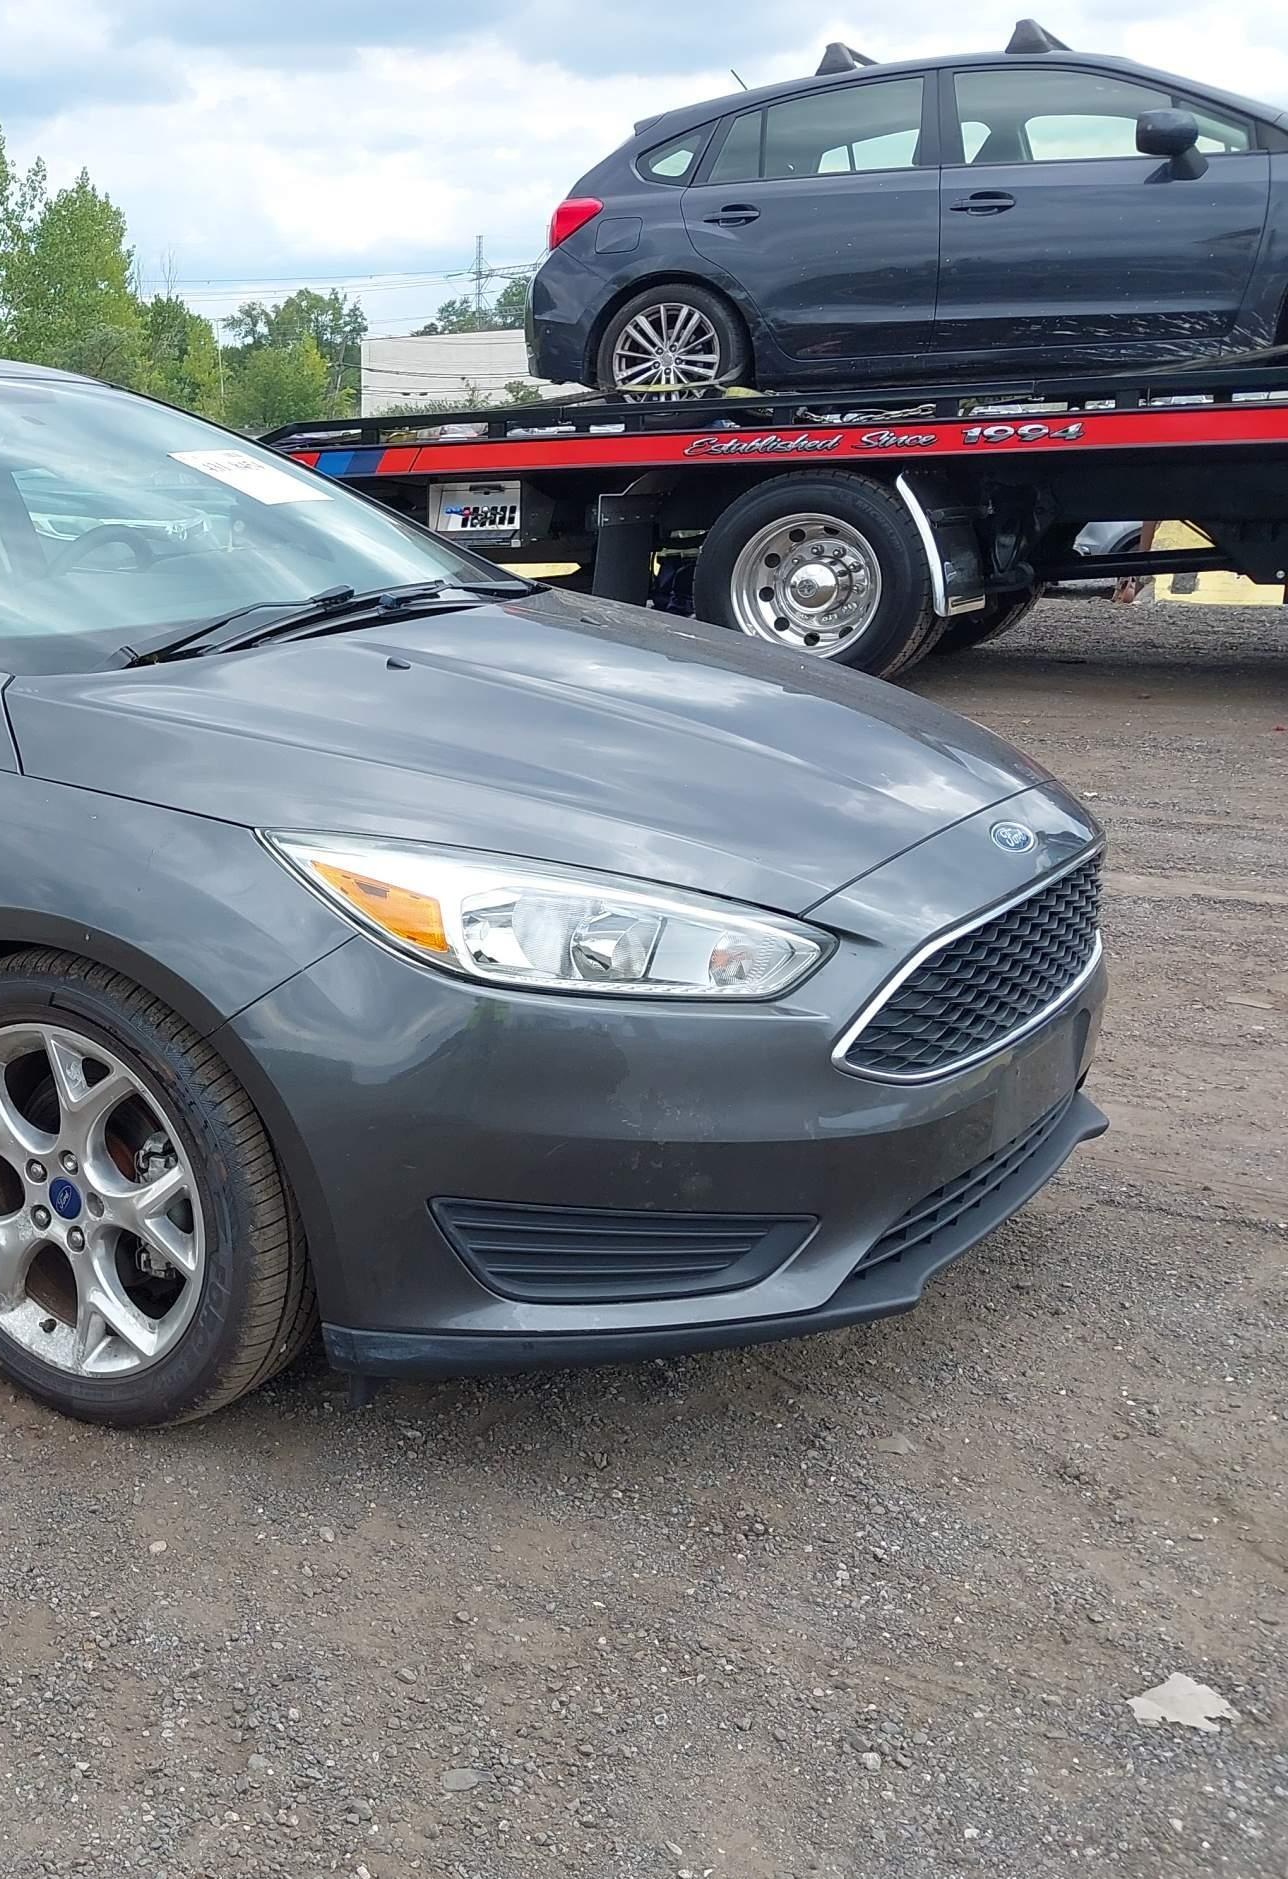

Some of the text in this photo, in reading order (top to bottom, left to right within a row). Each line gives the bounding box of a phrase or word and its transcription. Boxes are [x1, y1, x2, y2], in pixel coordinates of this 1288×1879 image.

[683, 422, 1086, 457] Established Since 1994
